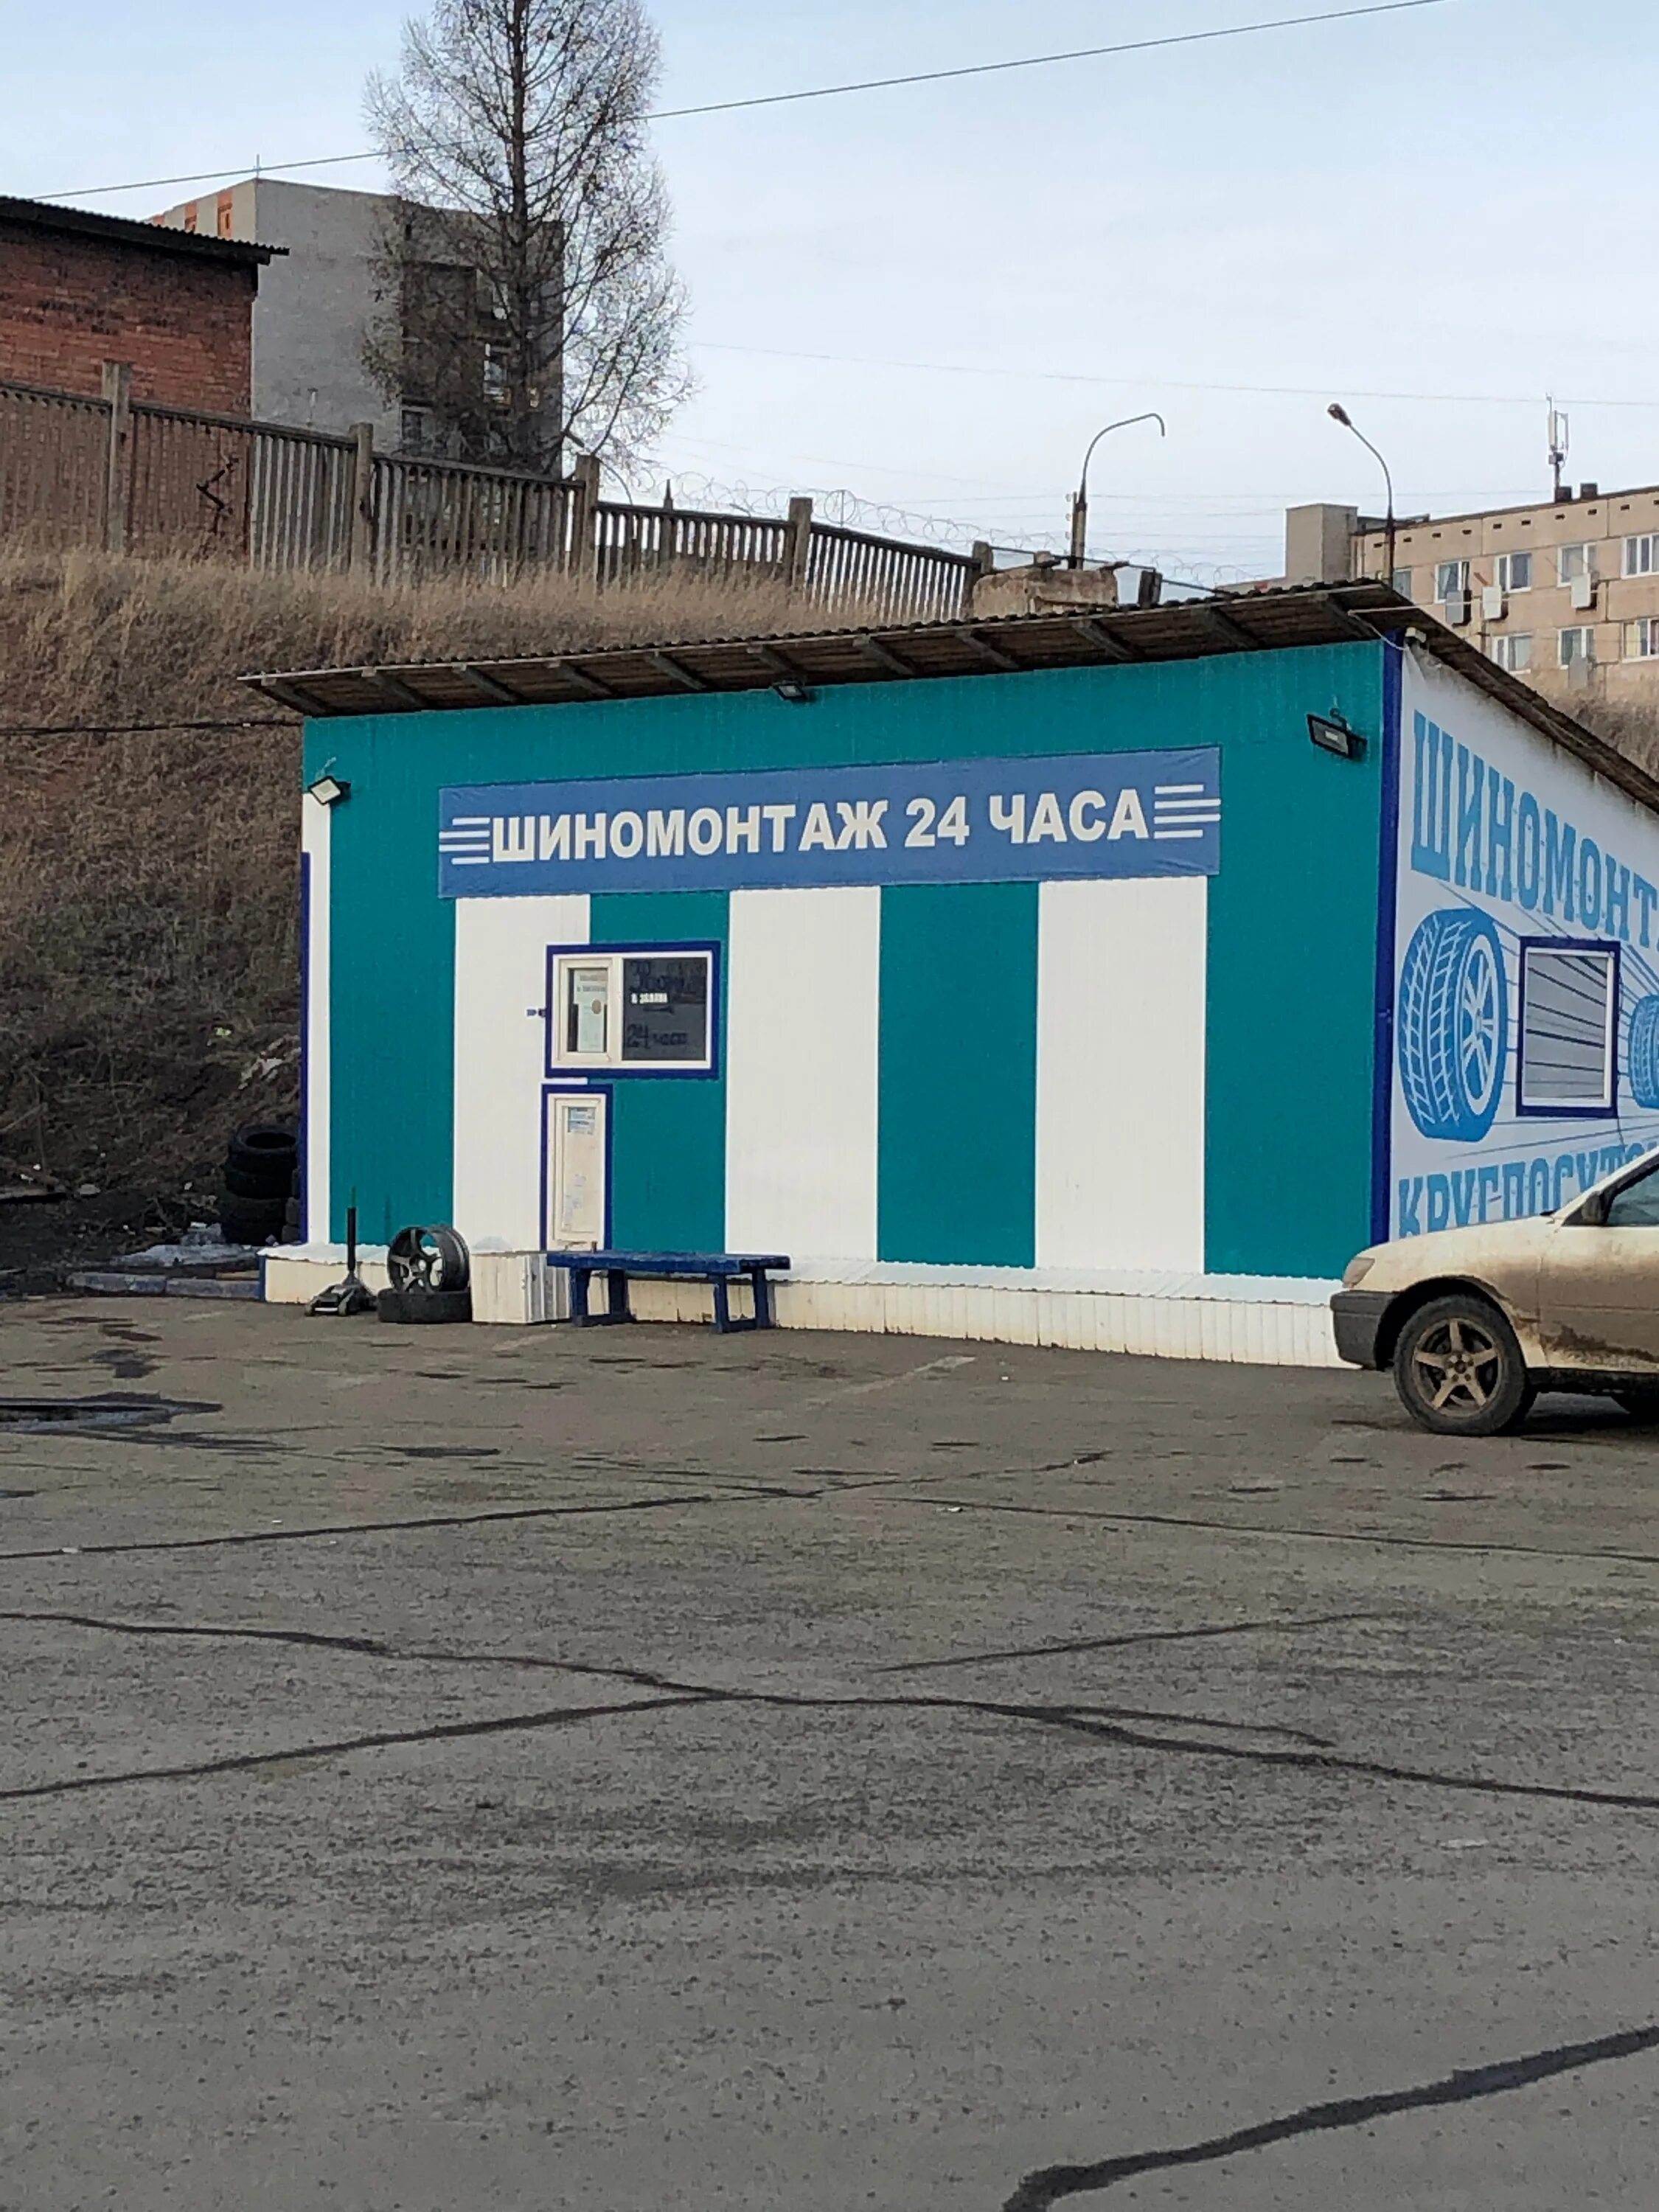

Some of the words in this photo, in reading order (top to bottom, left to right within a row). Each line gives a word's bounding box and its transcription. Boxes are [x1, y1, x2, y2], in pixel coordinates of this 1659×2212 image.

[493, 799, 888, 862] ШИНОМОНТАЖ
[905, 796, 970, 847] 24
[990, 788, 1149, 844] ЧАСА
[1411, 709, 1659, 948] ШИНОМОНТ
